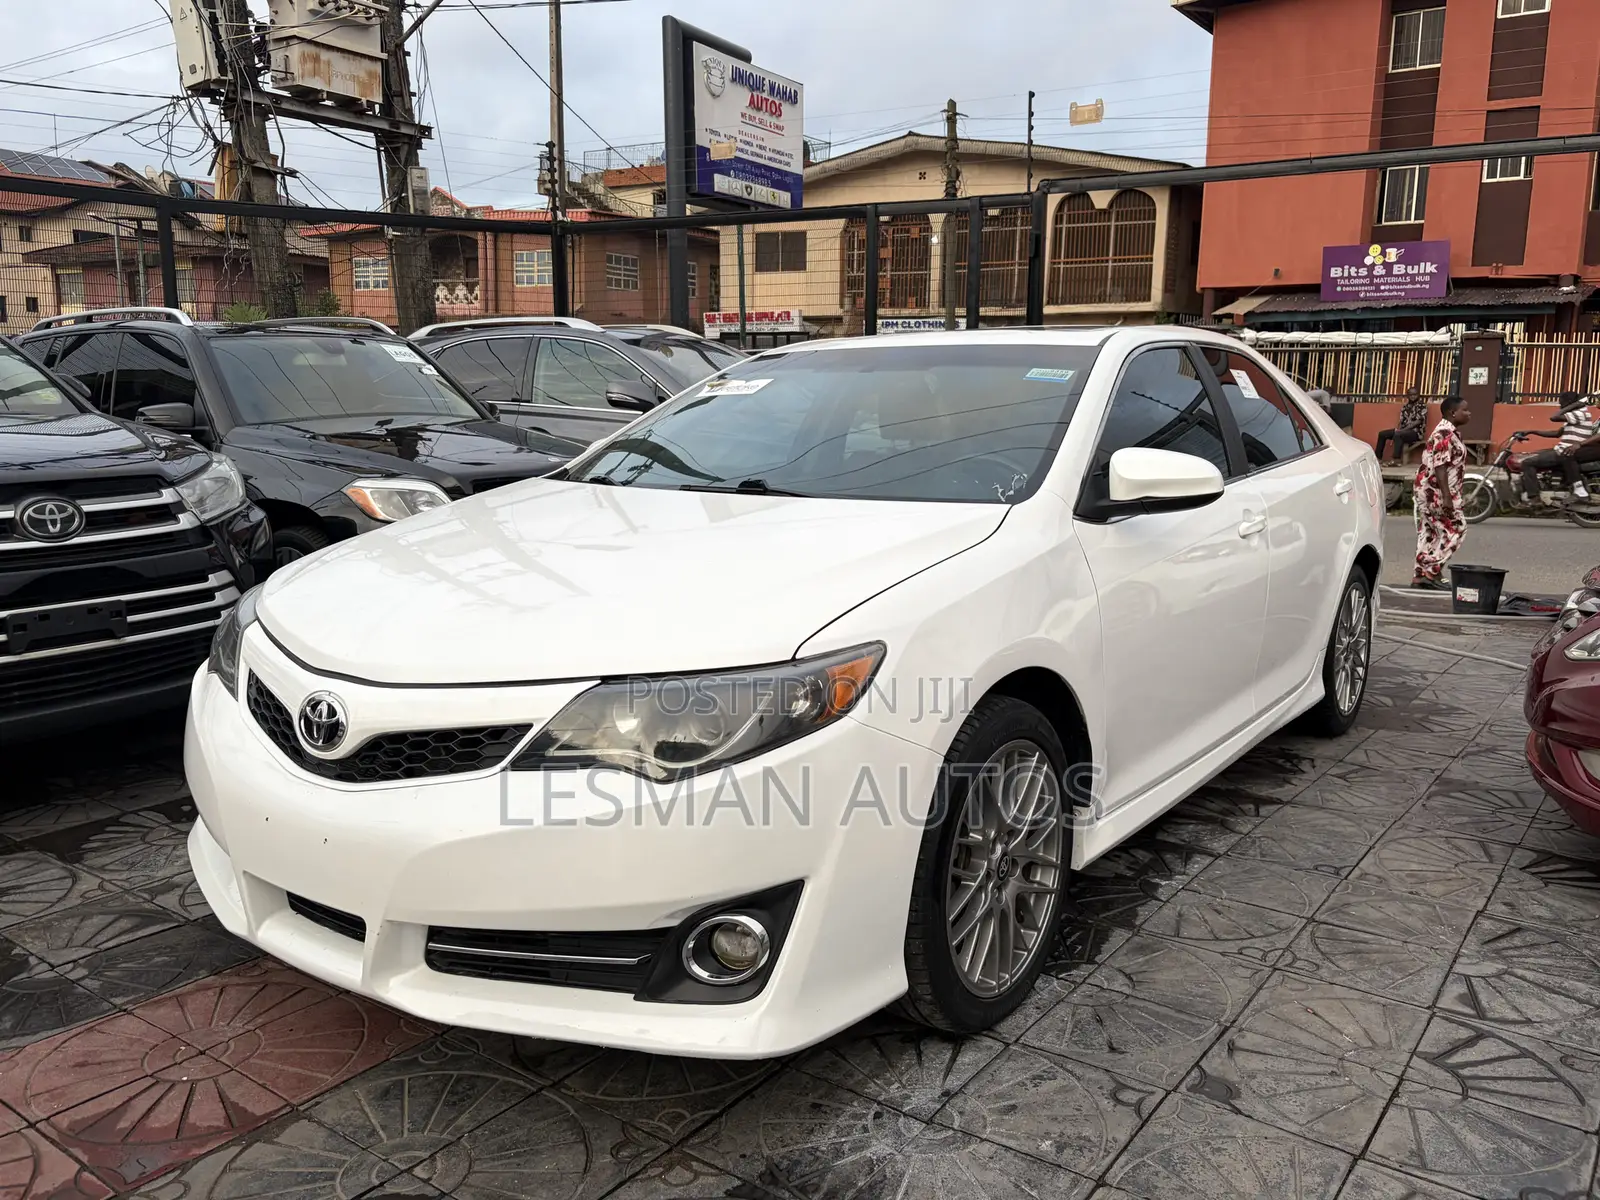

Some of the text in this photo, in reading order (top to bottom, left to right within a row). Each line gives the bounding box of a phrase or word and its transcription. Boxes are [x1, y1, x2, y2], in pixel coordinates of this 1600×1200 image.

[731, 64, 798, 105] UNIQUE WAHAB
[747, 92, 782, 118] AUTOS
[741, 112, 747, 121] WE
[758, 117, 768, 128] SELL
[773, 122, 784, 132] SWAP
[709, 128, 721, 137] TOYOTA
[782, 160, 791, 168] CARS
[1330, 262, 1438, 278] Bits & Bulk
[1373, 276, 1411, 284] MATERIALS
